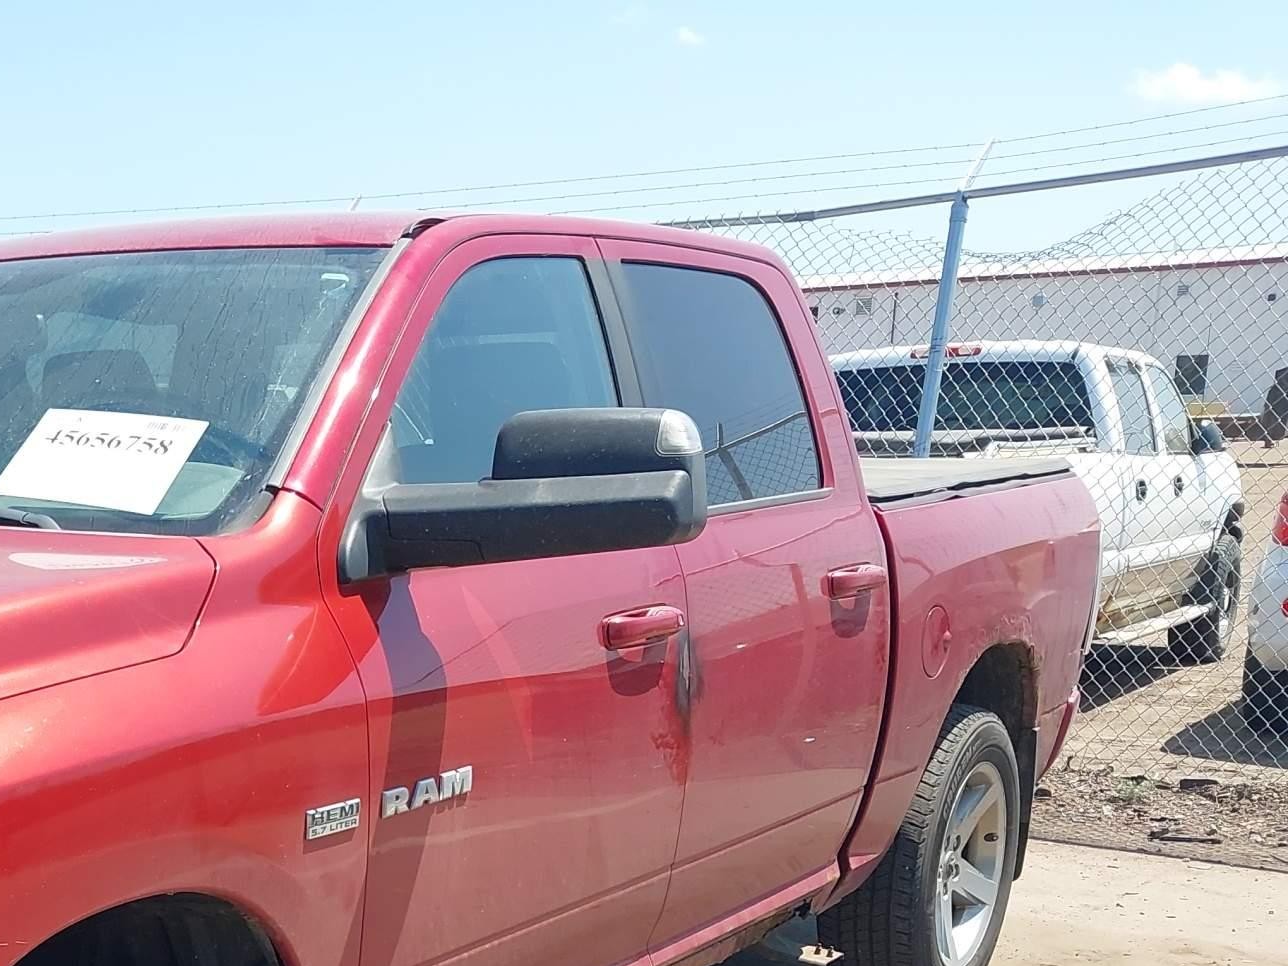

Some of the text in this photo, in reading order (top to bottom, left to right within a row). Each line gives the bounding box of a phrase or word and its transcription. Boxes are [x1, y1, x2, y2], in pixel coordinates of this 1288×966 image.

[45, 429, 174, 456] 45656758
[381, 765, 473, 819] RAM
[307, 799, 361, 828] HEMI
[311, 818, 358, 838] 5.7 LITER
